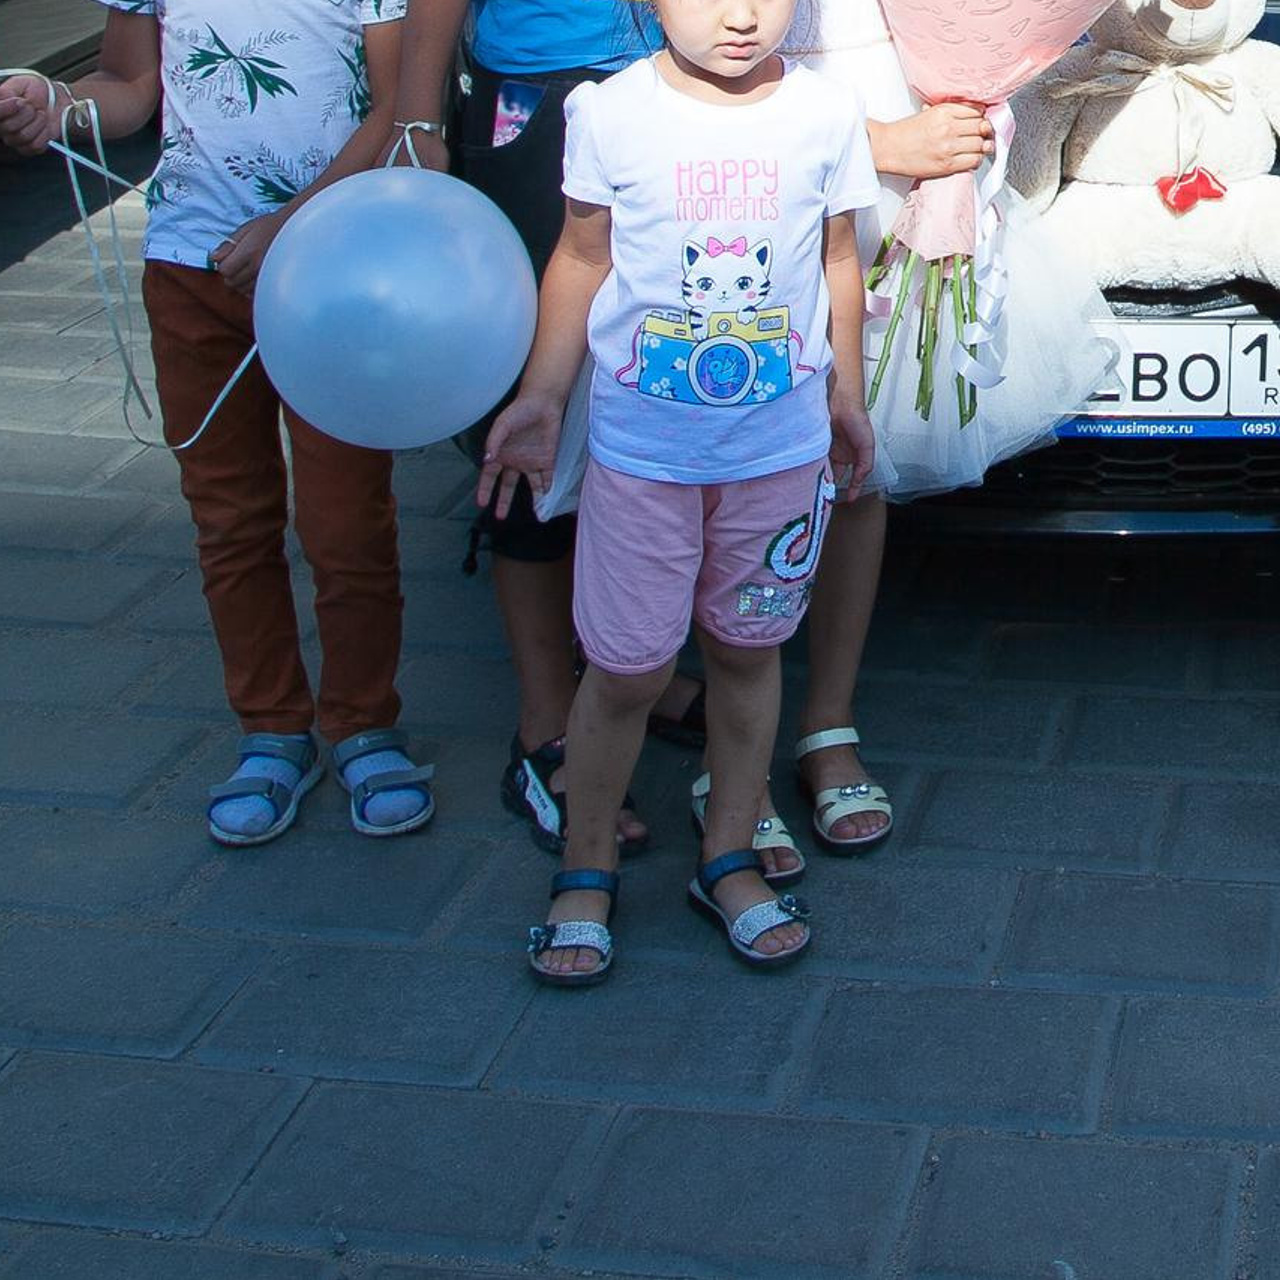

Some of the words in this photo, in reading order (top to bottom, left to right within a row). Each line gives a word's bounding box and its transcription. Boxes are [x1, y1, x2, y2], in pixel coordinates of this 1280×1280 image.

[676, 196, 780, 221] moments
[1076, 422, 1194, 437] www.usimpex.ru
[1242, 422, 1277, 436] (495)
